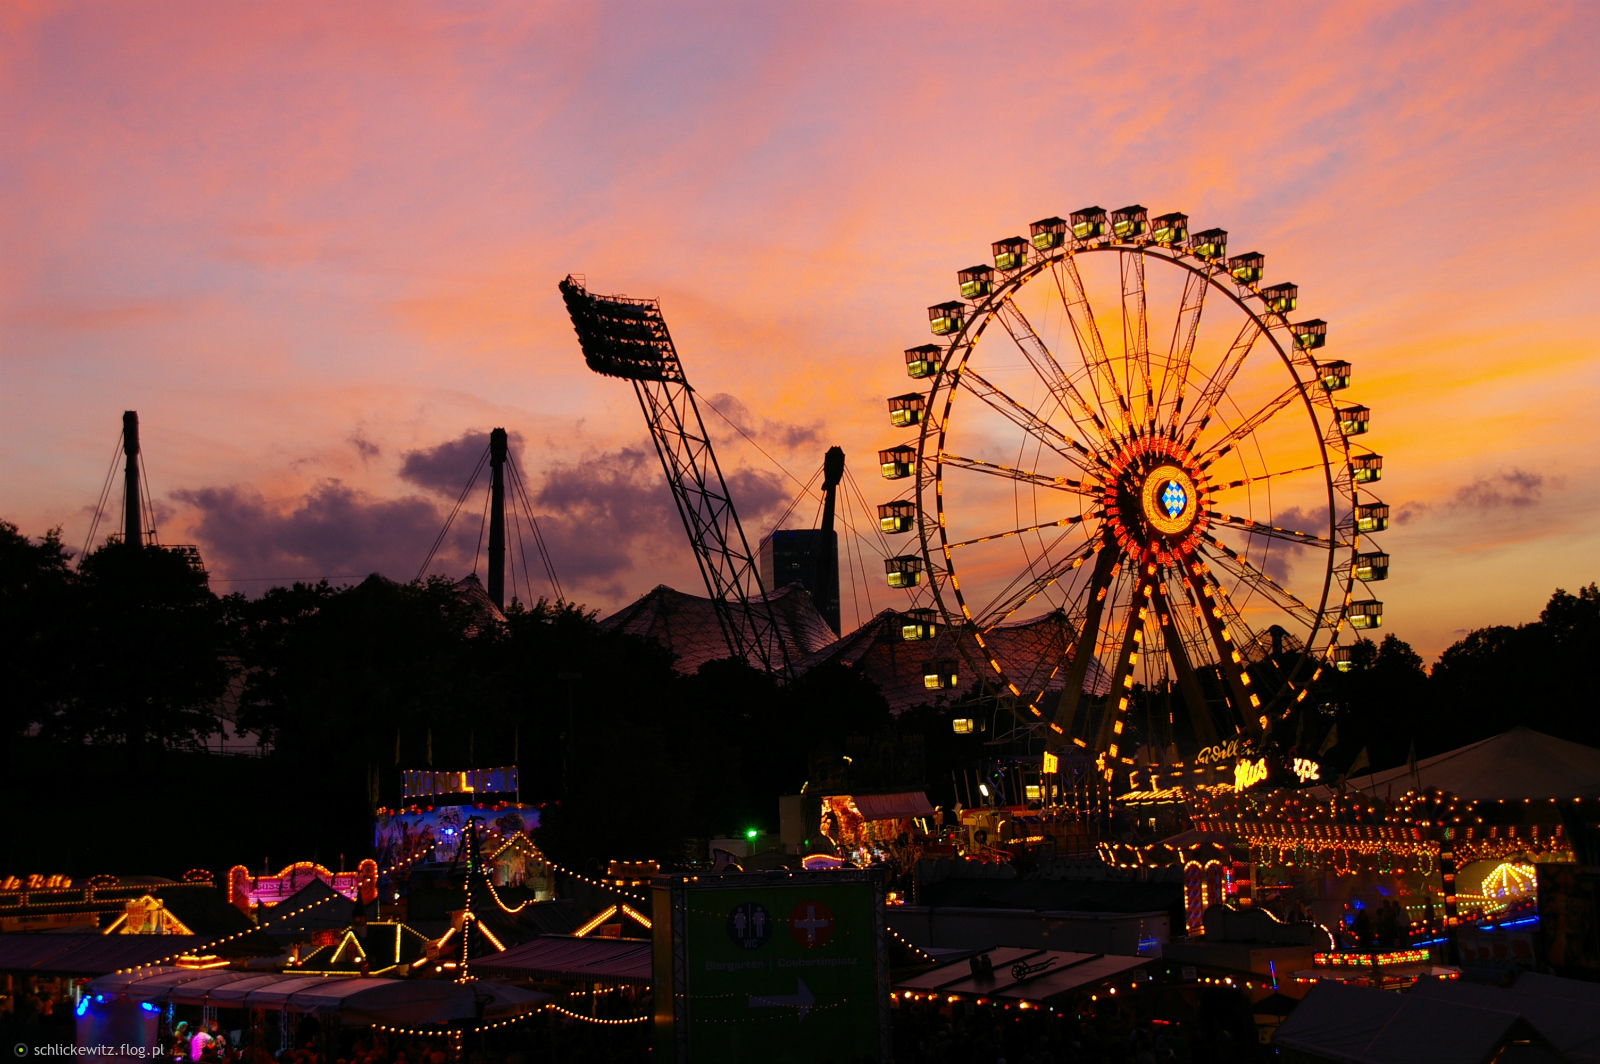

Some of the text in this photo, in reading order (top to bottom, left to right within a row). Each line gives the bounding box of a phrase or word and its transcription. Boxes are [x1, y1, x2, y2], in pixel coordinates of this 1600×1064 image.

[407, 767, 515, 797] MONDLIFT
[743, 938, 758, 948] WC
[706, 957, 858, 972] Biergarten Coubertinplatz
